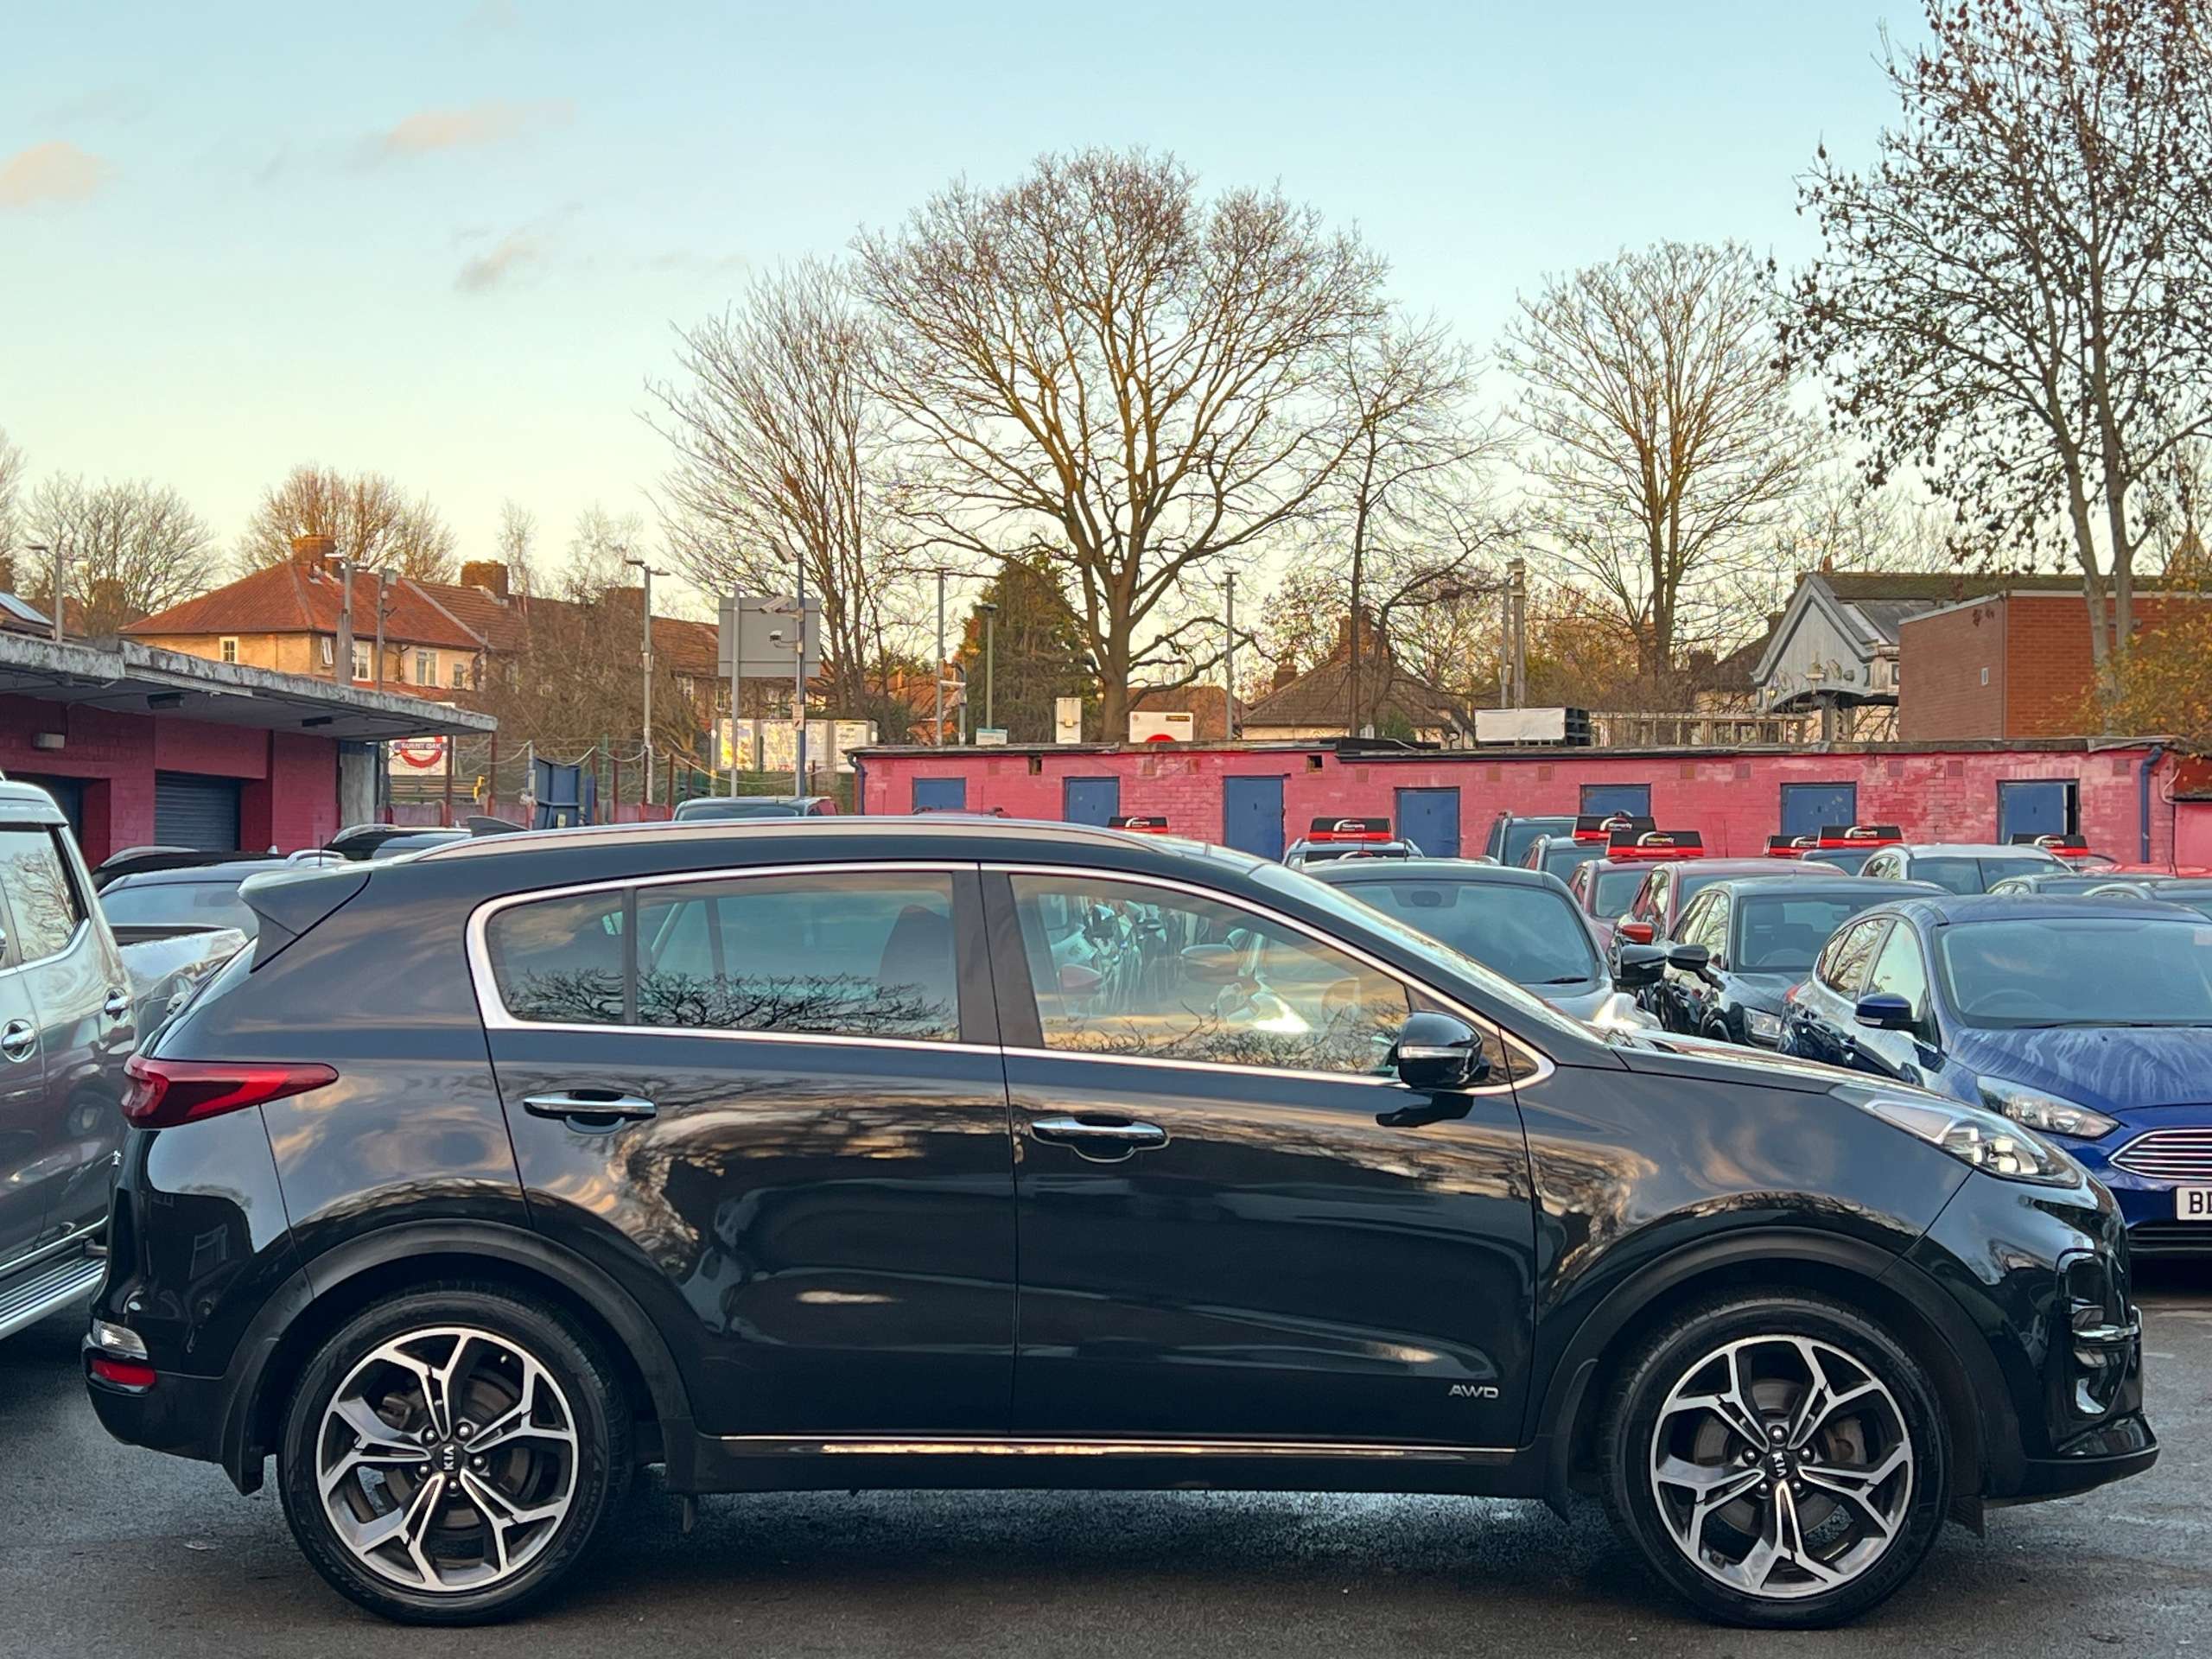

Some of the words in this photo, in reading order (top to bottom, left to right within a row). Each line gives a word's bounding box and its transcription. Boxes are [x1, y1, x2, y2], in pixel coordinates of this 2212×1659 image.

[1448, 1384, 1499, 1398] AWD
[443, 1445, 454, 1470] KIA
[1772, 1452, 1787, 1477] KIA
